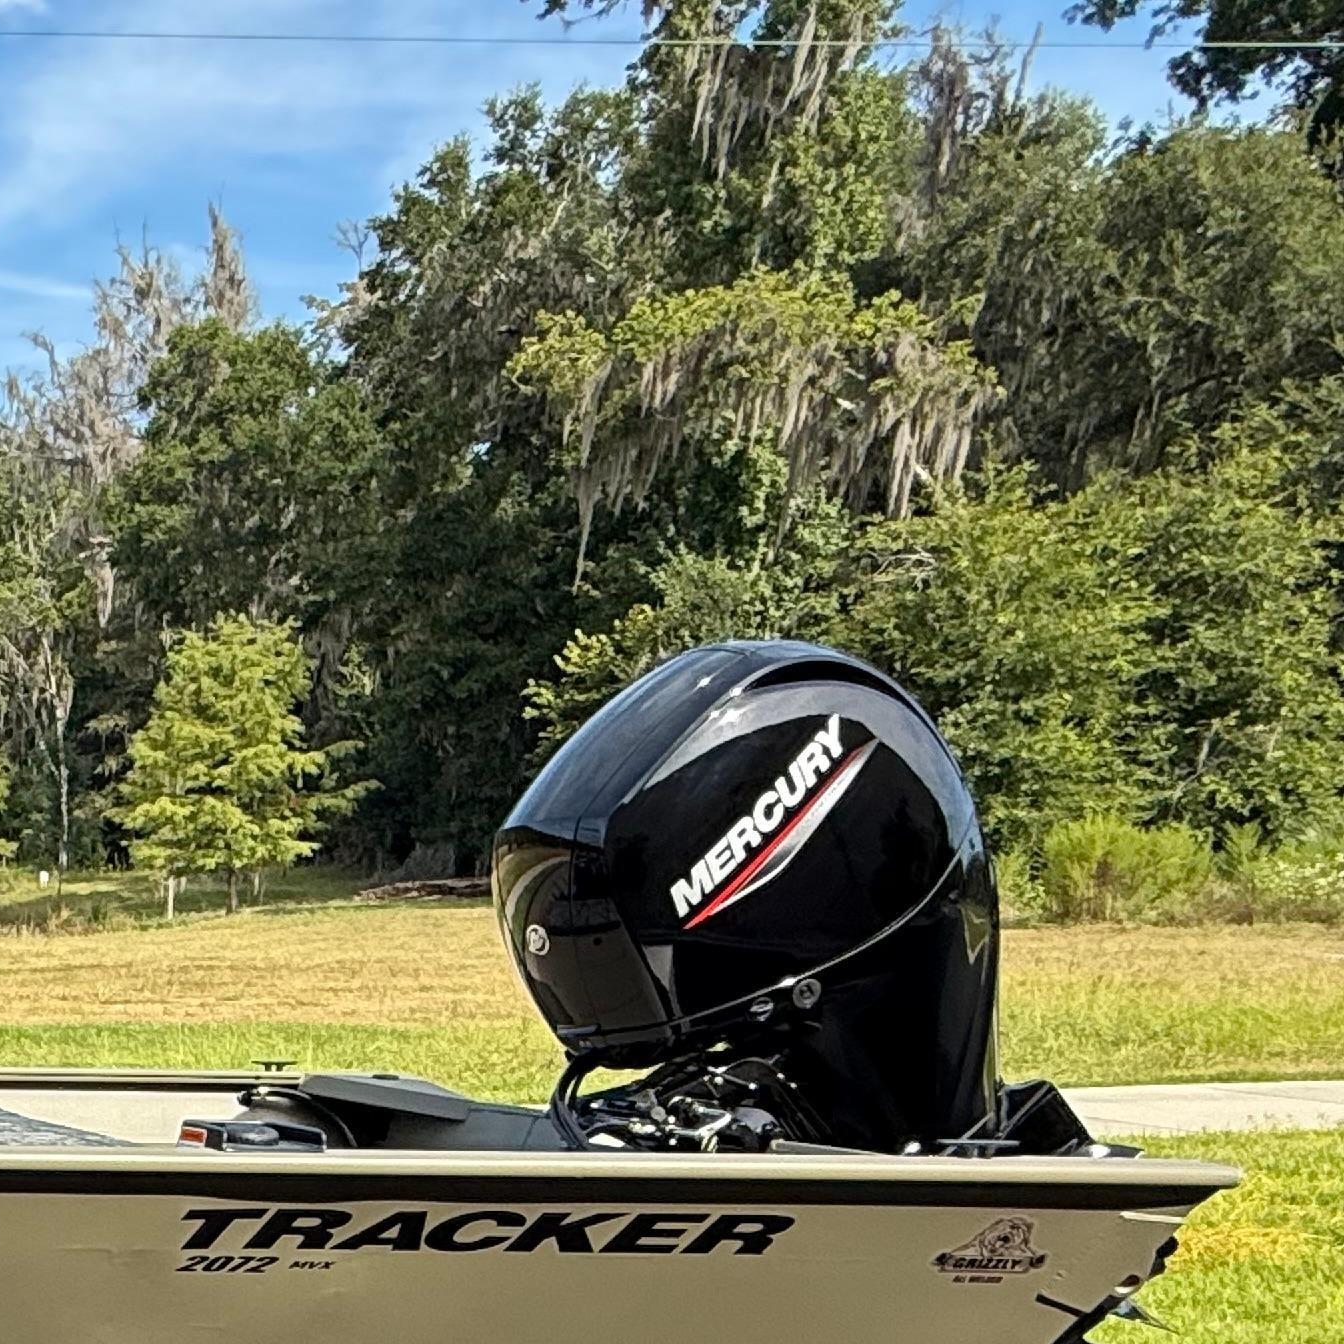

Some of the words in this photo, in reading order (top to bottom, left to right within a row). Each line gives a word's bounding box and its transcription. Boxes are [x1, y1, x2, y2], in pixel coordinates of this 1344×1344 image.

[670, 713, 843, 918] MERCURY
[181, 1208, 795, 1255] TRACKER
[175, 1255, 279, 1273] 2072
